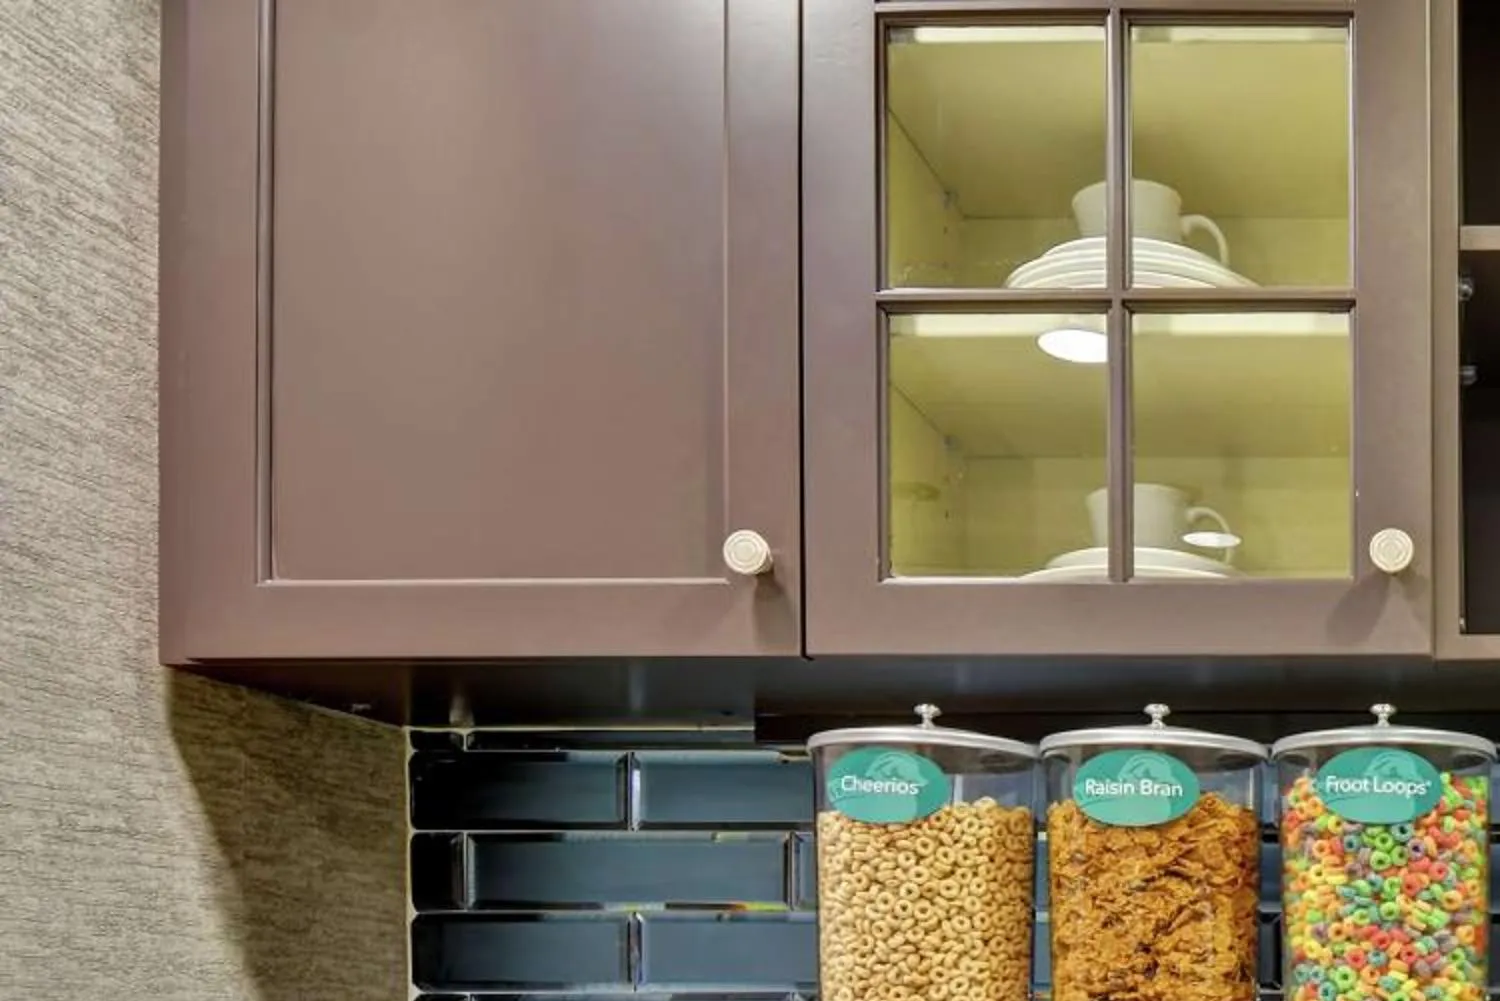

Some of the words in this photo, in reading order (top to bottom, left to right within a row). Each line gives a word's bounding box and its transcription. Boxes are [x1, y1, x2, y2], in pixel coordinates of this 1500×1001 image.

[841, 775, 919, 795] Cheerios
[1085, 778, 1135, 796] Raisin
[1140, 779, 1183, 797] Bran
[1326, 775, 1370, 793] Froot
